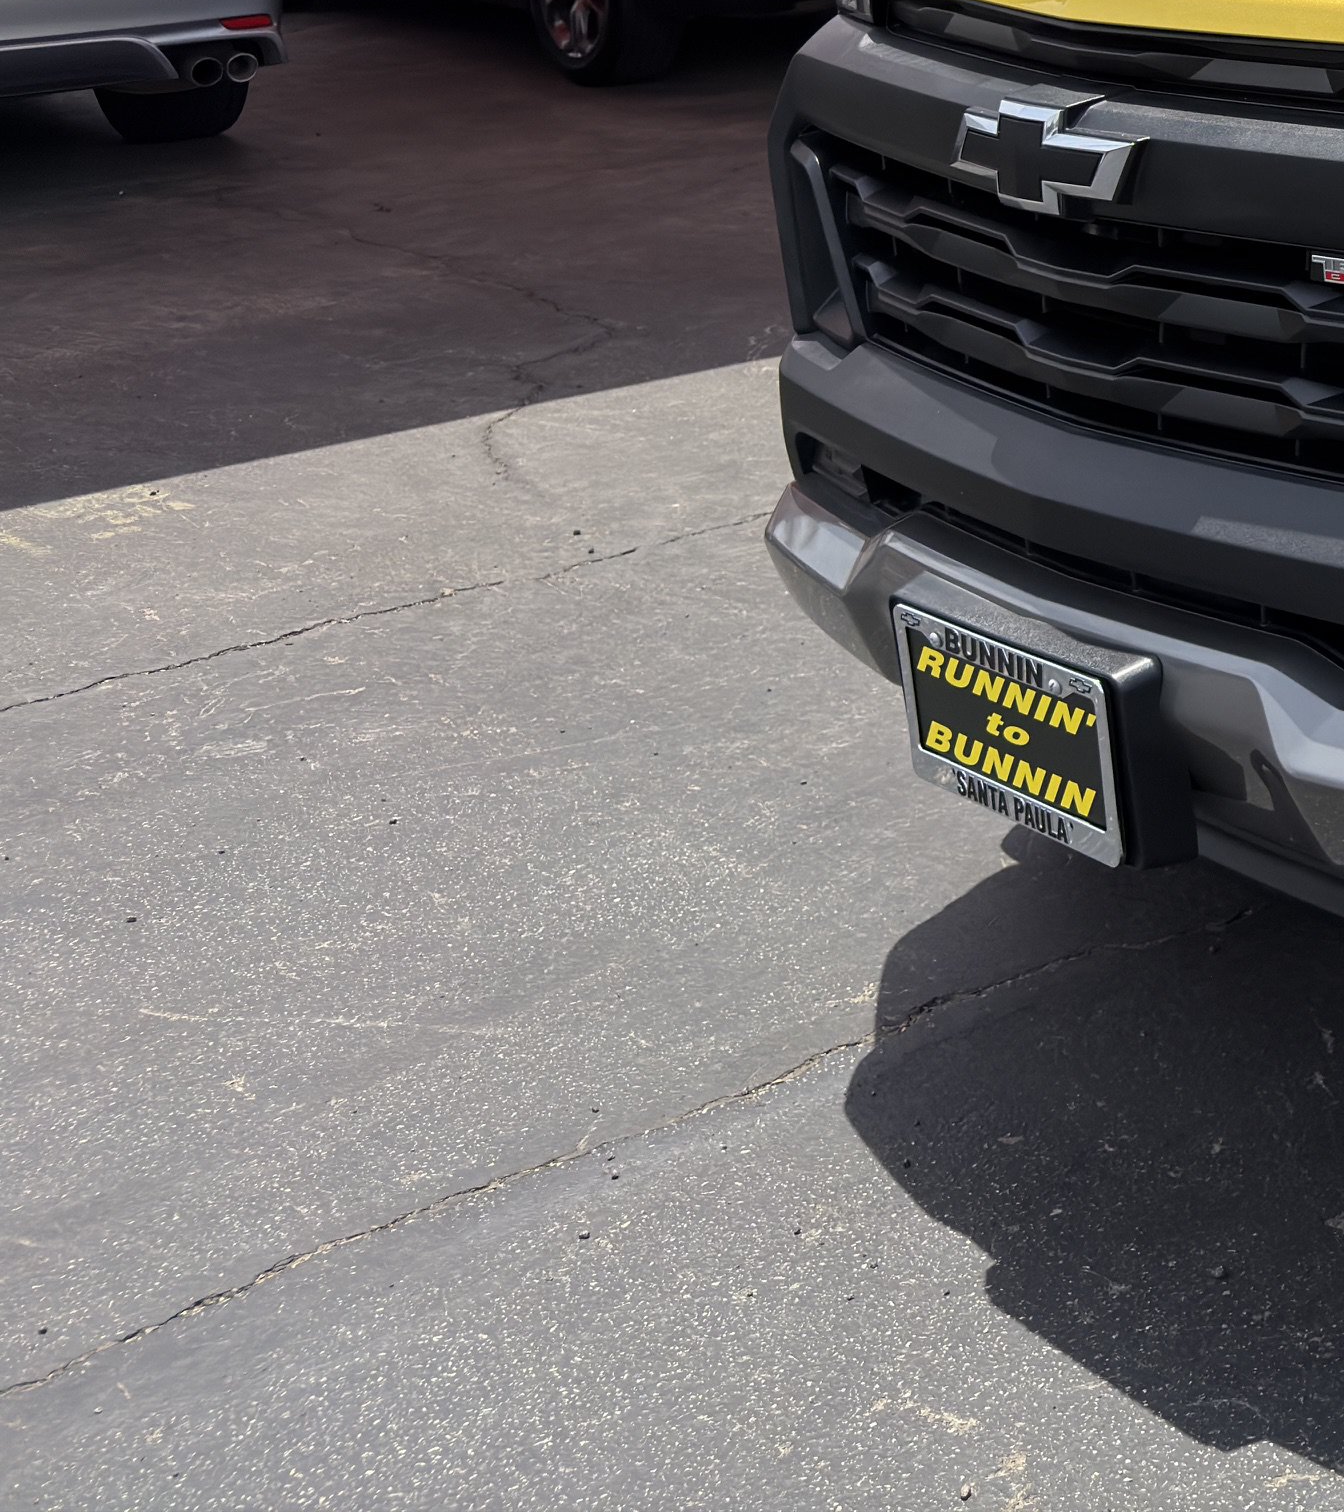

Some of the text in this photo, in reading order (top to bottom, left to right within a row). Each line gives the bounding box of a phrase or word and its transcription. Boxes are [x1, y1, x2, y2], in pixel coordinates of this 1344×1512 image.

[917, 646, 1097, 735] RUNNIN'
[944, 626, 1043, 687] BUNNIN
[986, 712, 1030, 746] to
[925, 720, 1097, 817] BUNNIN
